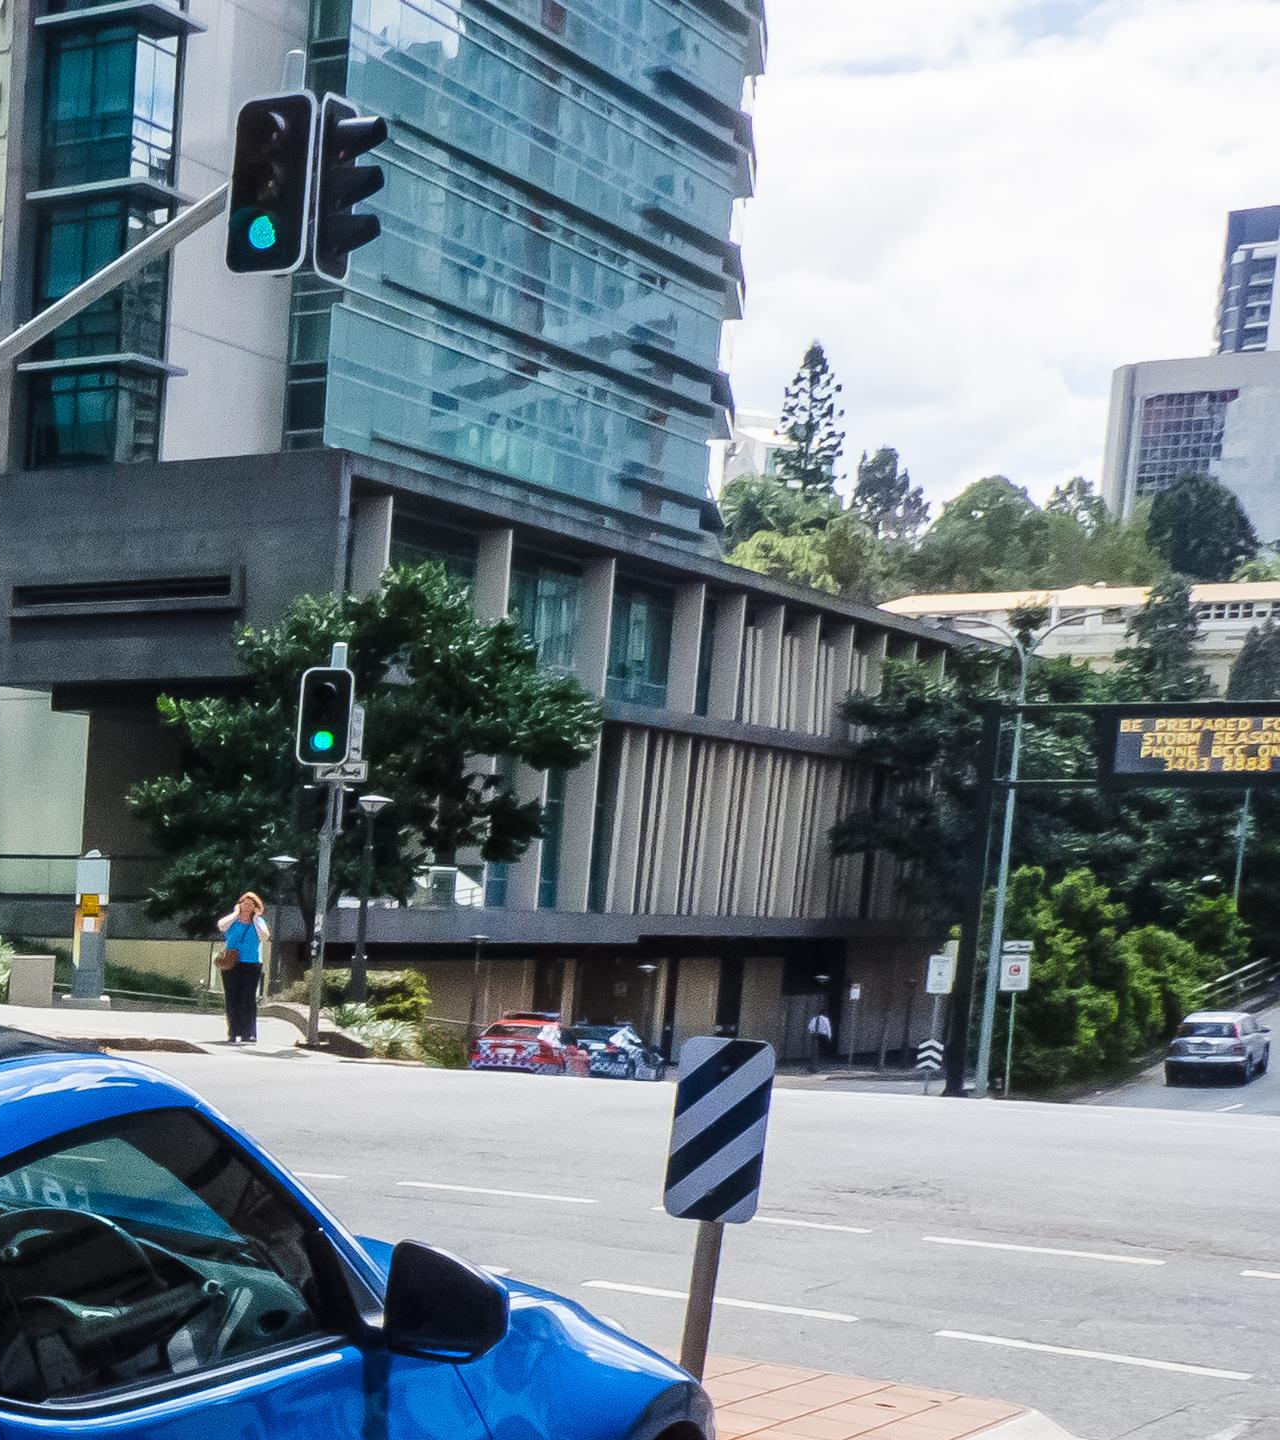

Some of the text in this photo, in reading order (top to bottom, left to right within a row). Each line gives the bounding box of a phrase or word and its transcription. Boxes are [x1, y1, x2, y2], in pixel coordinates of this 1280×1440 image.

[1120, 719, 1142, 732] BE
[1155, 717, 1252, 731] PREPARED
[1142, 732, 1201, 745] STORM
[1141, 745, 1198, 758] PHONE
